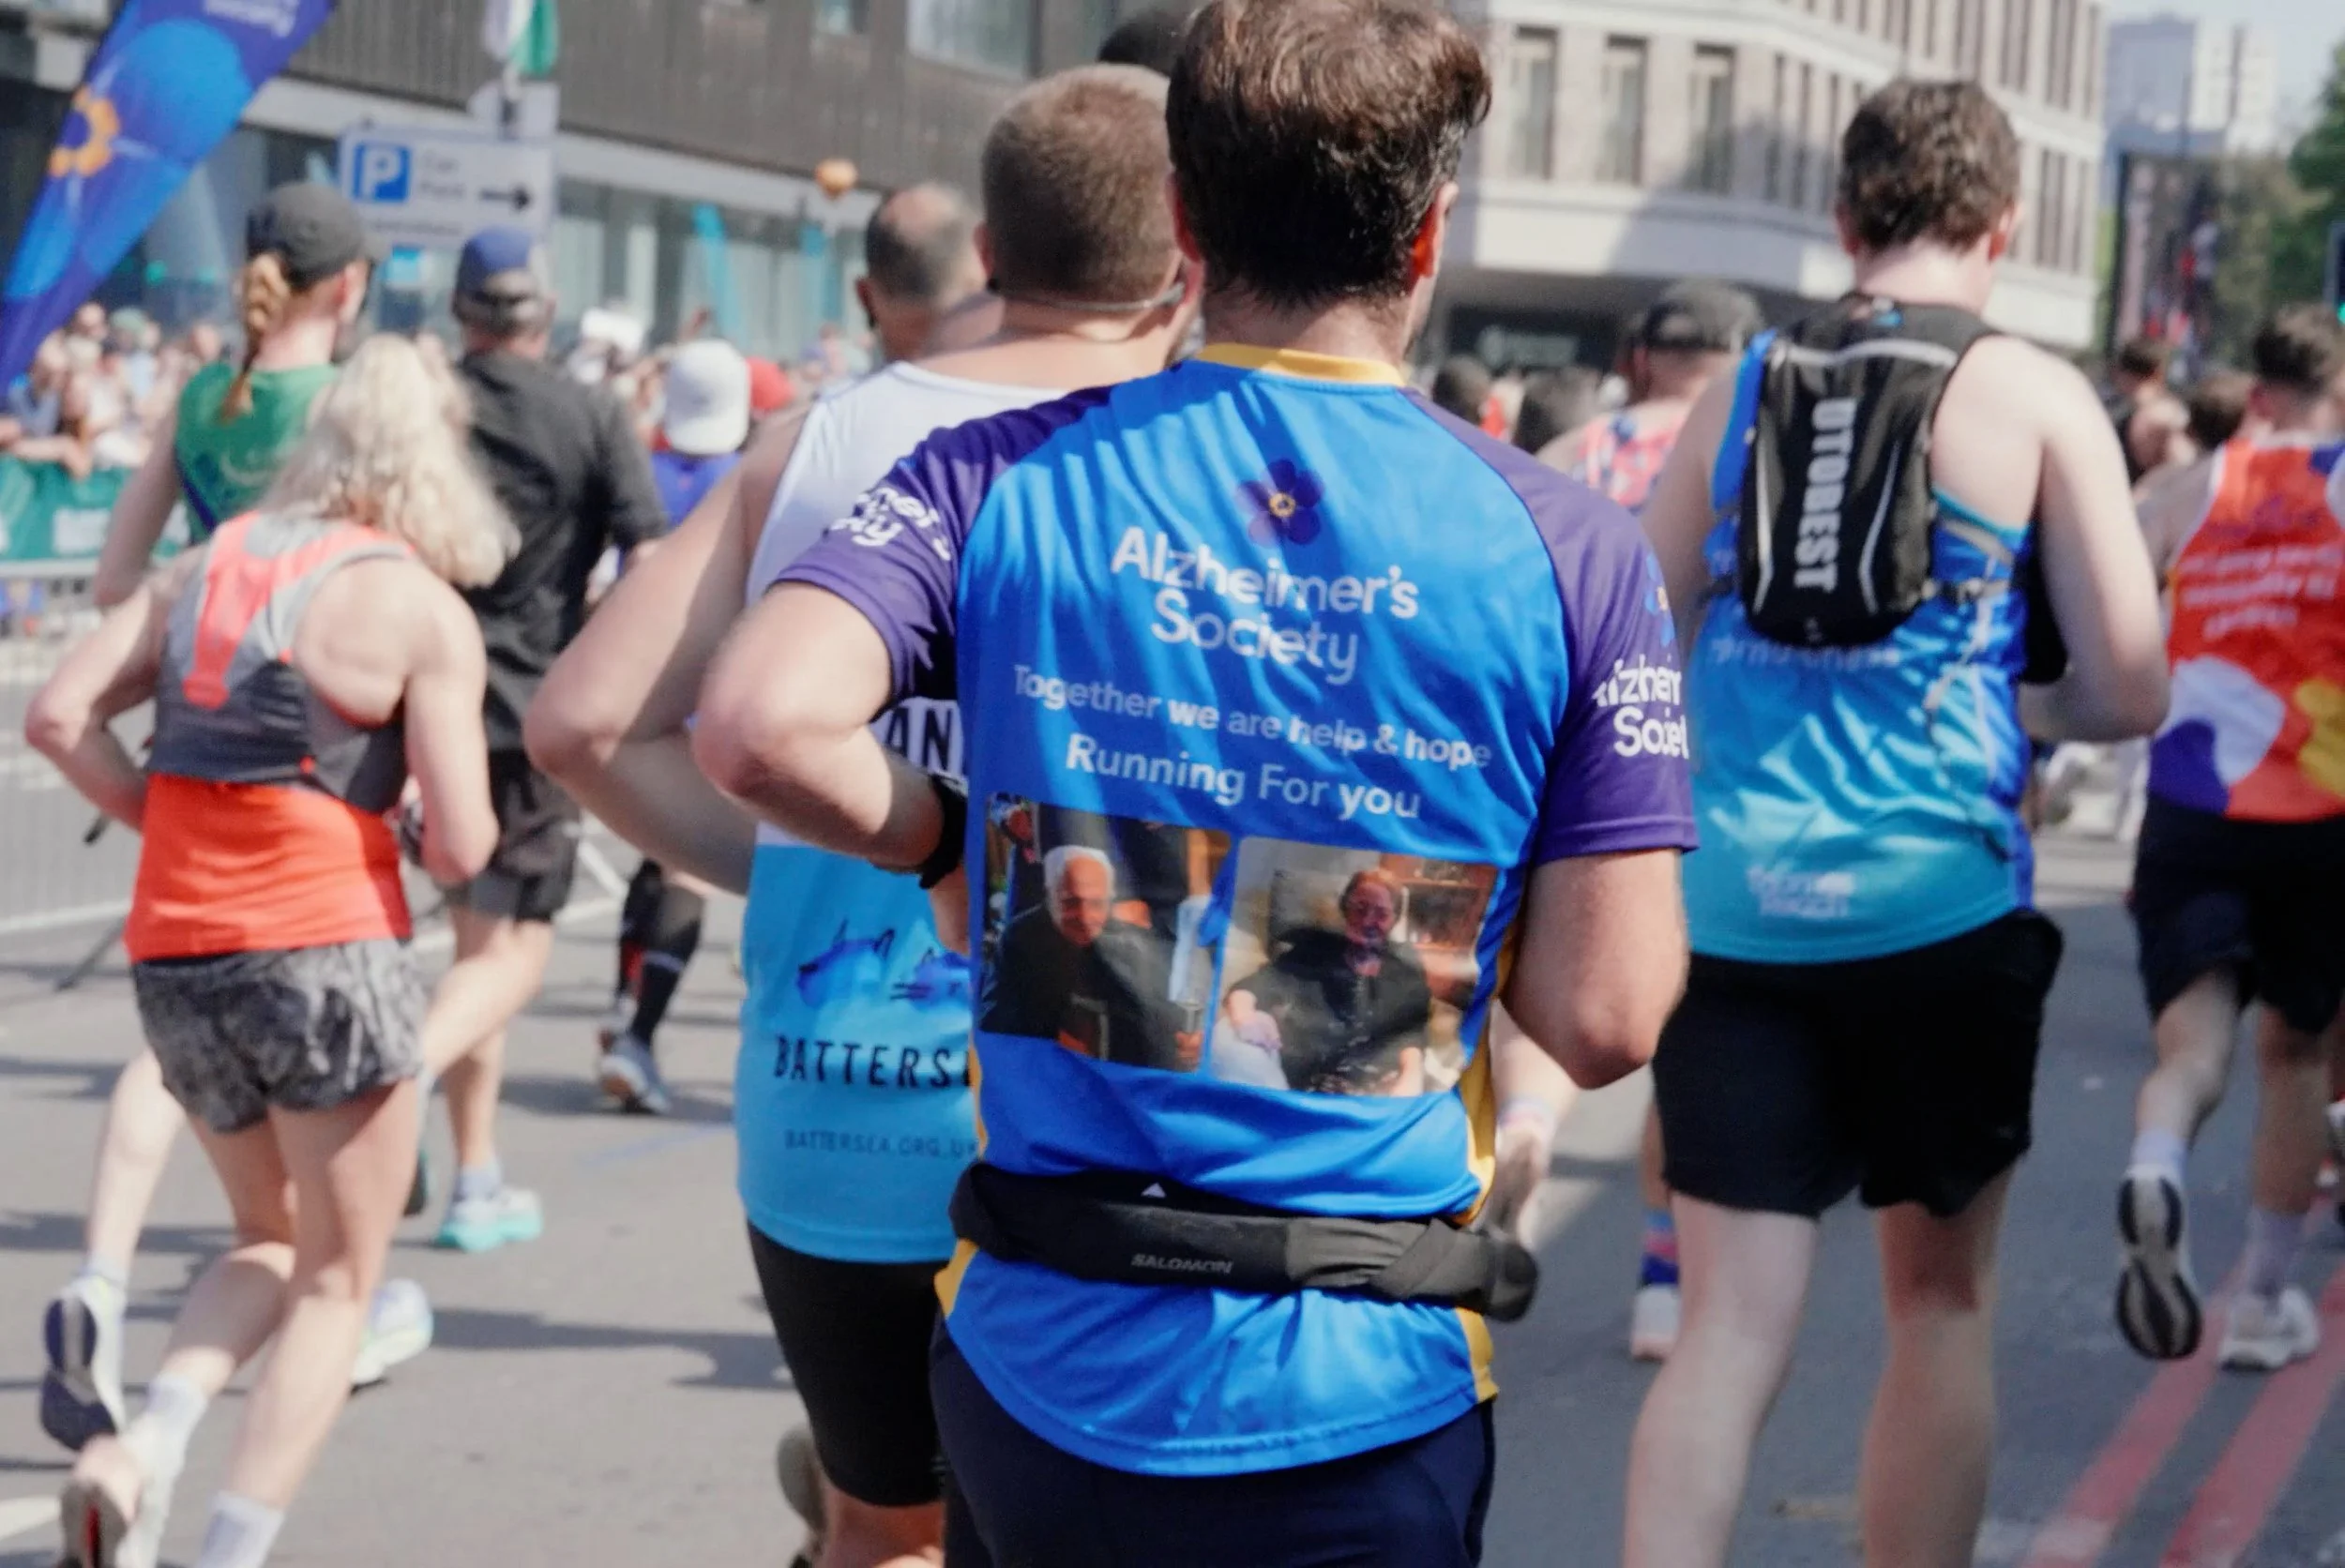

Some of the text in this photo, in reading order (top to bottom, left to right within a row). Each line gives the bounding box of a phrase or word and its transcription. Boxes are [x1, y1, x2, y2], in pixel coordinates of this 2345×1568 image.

[361, 149, 401, 200] P
[1793, 397, 1857, 594] UTOBEST
[1112, 526, 1419, 619] Alzheimer's
[1150, 589, 1358, 686] Society
[1014, 665, 1491, 771] Together we are help & hope
[1066, 733, 1423, 821] Running For you
[774, 1033, 971, 1089] BATTERS
[1130, 1253, 1233, 1275] SALOMON
